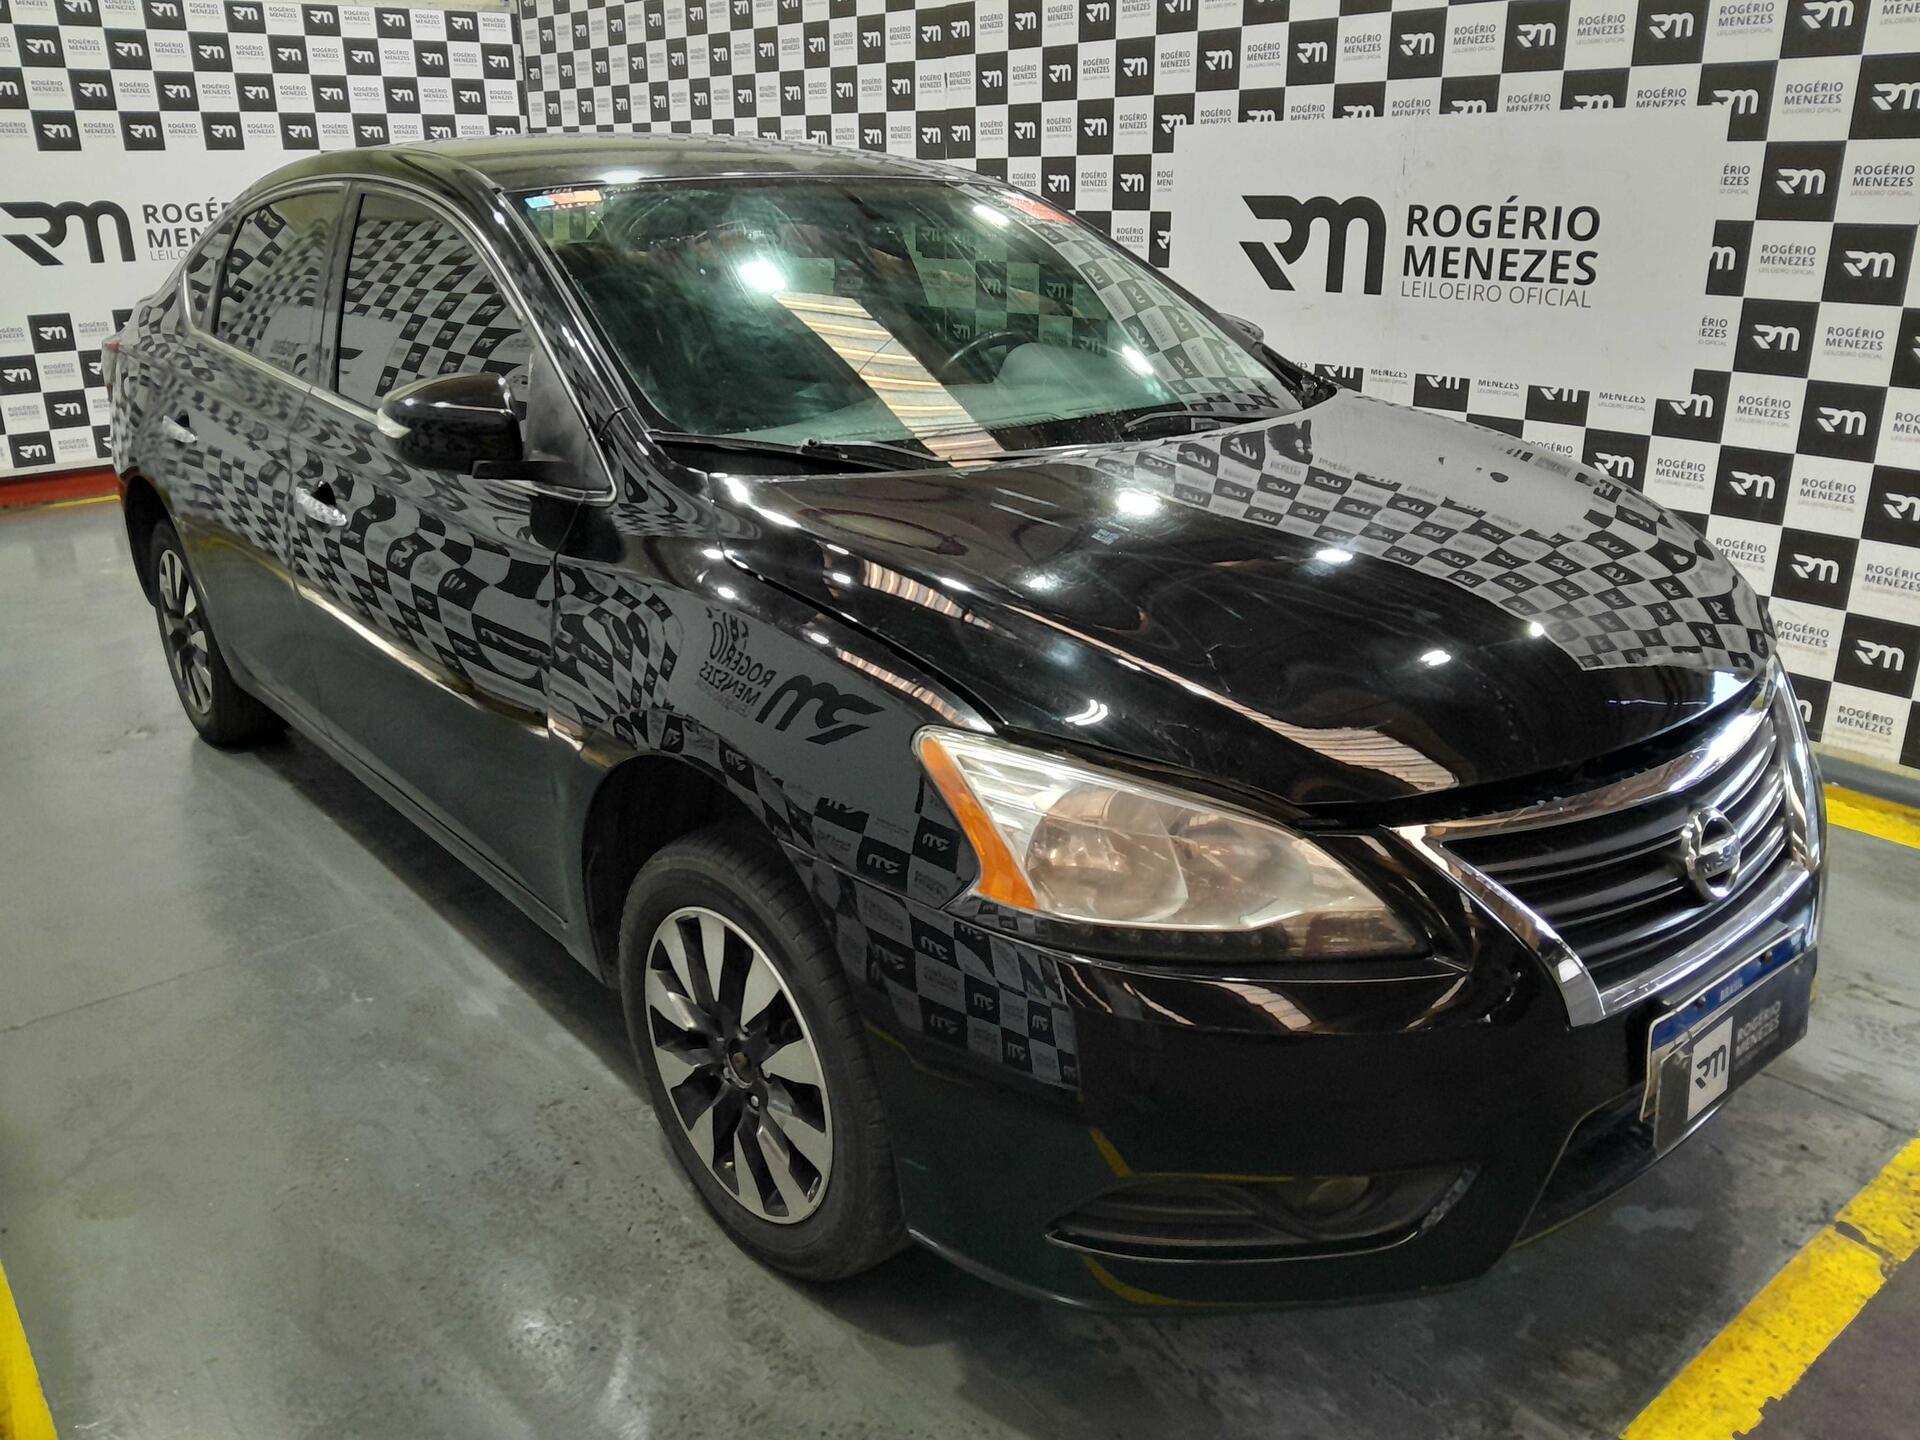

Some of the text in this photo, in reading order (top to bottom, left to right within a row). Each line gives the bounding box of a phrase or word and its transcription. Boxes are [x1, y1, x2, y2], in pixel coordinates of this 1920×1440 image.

[1720, 1, 1774, 15] ROGÉRIO
[1578, 13, 1625, 25] ROGÉRIO
[1719, 14, 1772, 26] MENEZES
[1454, 23, 1496, 35] ROGÉRIO
[1577, 25, 1624, 36] MENEZES
[1454, 34, 1495, 46] MENEZES
[1638, 87, 1686, 98] ROGÉRIO
[1786, 81, 1843, 93] ROGÉRIO
[1393, 98, 1431, 108] ROGÉRIO
[1508, 92, 1550, 103] ROGÉRIO
[1784, 94, 1841, 104] MENEZES
[1723, 162, 1751, 175] ÉRIO
[1855, 163, 1914, 175] ROGÉRIO
[1720, 176, 1749, 185] EZES
[1853, 177, 1913, 186] MENEZES
[142, 197, 226, 224] ROGÉ
[1406, 195, 1601, 241] ROGÉRIO
[1116, 226, 1144, 235] ROGÉRIO
[1762, 243, 1816, 255] ROGÉRIO
[1403, 245, 1599, 286] MENEZES
[1760, 256, 1814, 266] MENEZES
[1401, 281, 1592, 308] LEILOEIRO OFICIAL
[1702, 315, 1728, 327] ÉRIO
[1828, 326, 1884, 339] ROGÉRIO
[1826, 338, 1882, 350] MENEZES
[1739, 395, 1790, 408] ROGÉRIO
[1737, 406, 1789, 419] MENEZES
[1658, 457, 1705, 472] ROGÉRIO
[1656, 468, 1704, 482] MENEZES
[1802, 477, 1856, 493] ROGÉRIO
[1800, 489, 1854, 504] MENEZES
[1716, 537, 1767, 554] ROGÉRIO
[1776, 619, 1830, 638] ROGÉRIO
[1839, 705, 1893, 725] ROGÉRIO
[1837, 716, 1891, 735] MENEZES
